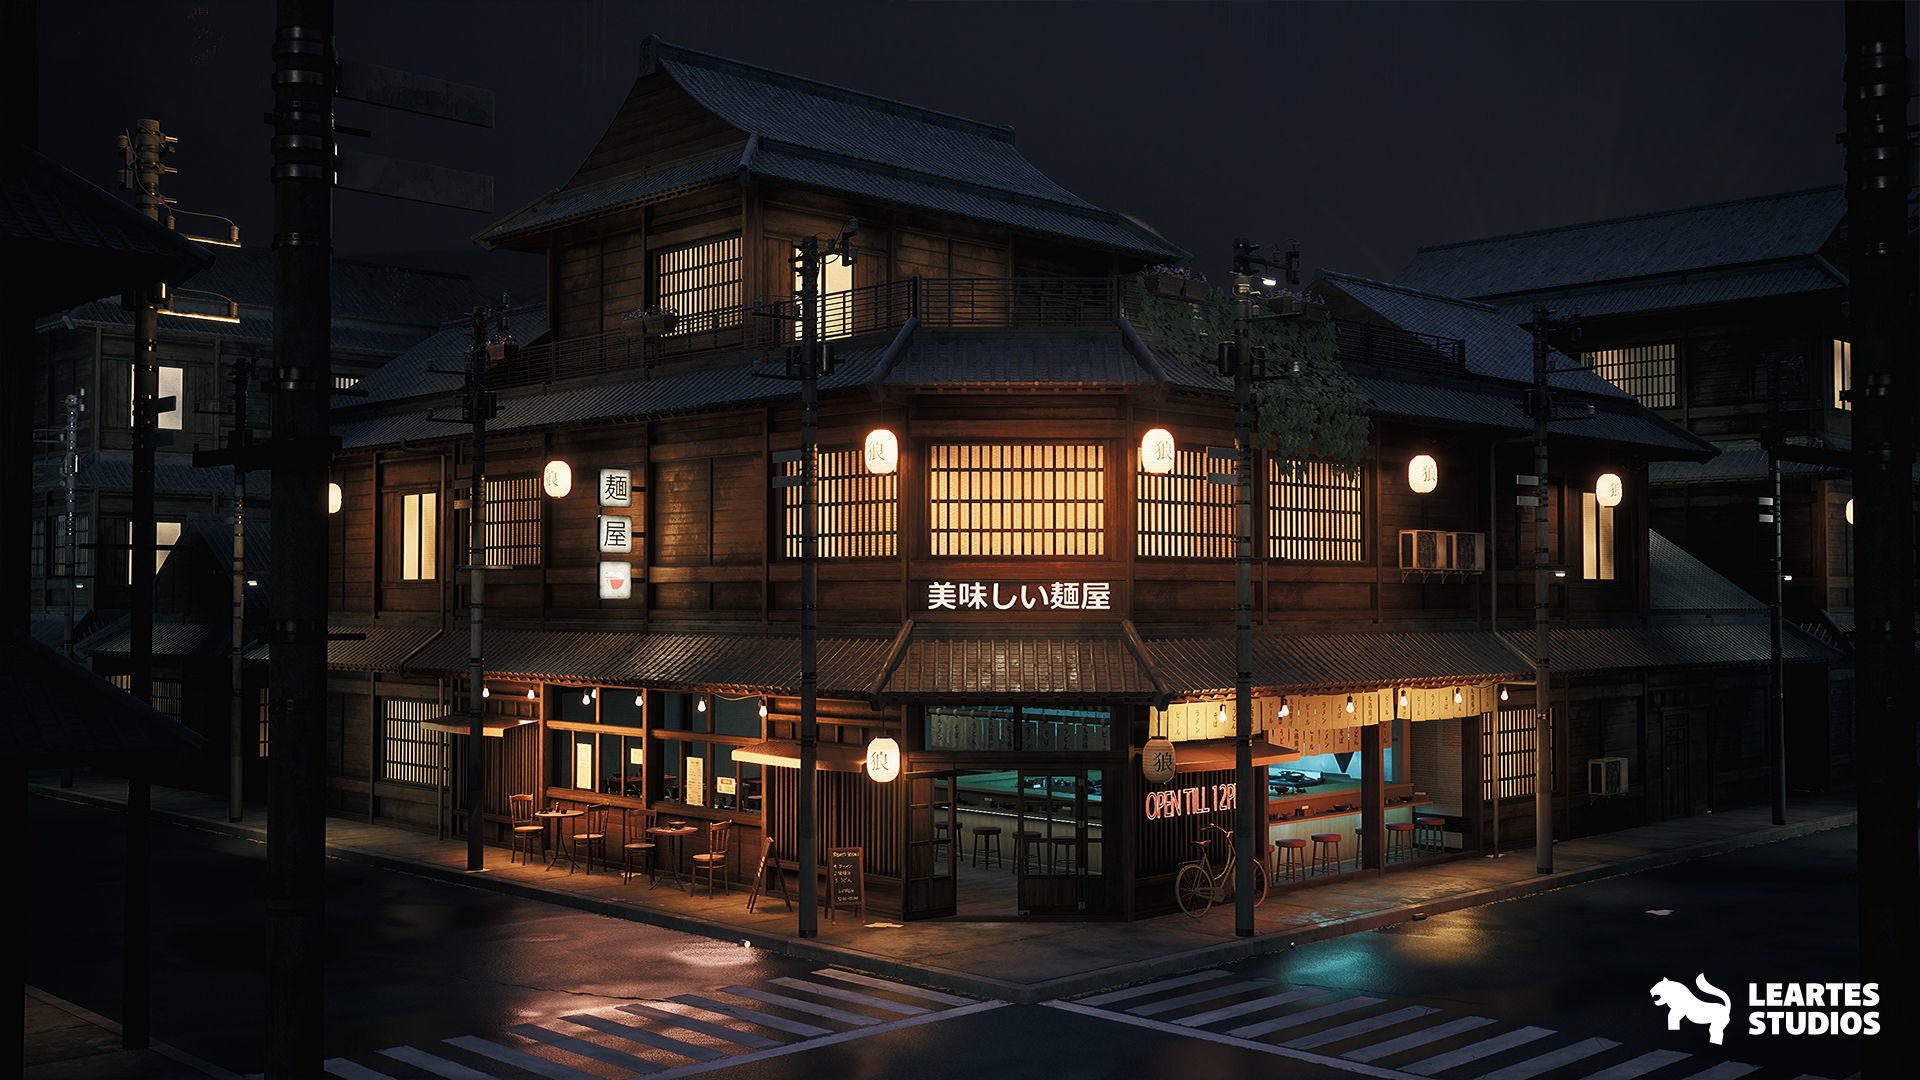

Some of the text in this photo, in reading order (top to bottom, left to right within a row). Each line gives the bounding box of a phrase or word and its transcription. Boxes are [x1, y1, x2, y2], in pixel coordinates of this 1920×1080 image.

[1153, 440, 1173, 461] 狼
[928, 581, 1111, 610] 美味しい麺屋
[871, 751, 889, 771] 狼
[1153, 752, 1173, 772] 狼
[1145, 789, 1182, 820] OPEN
[1182, 786, 1210, 815] TILL
